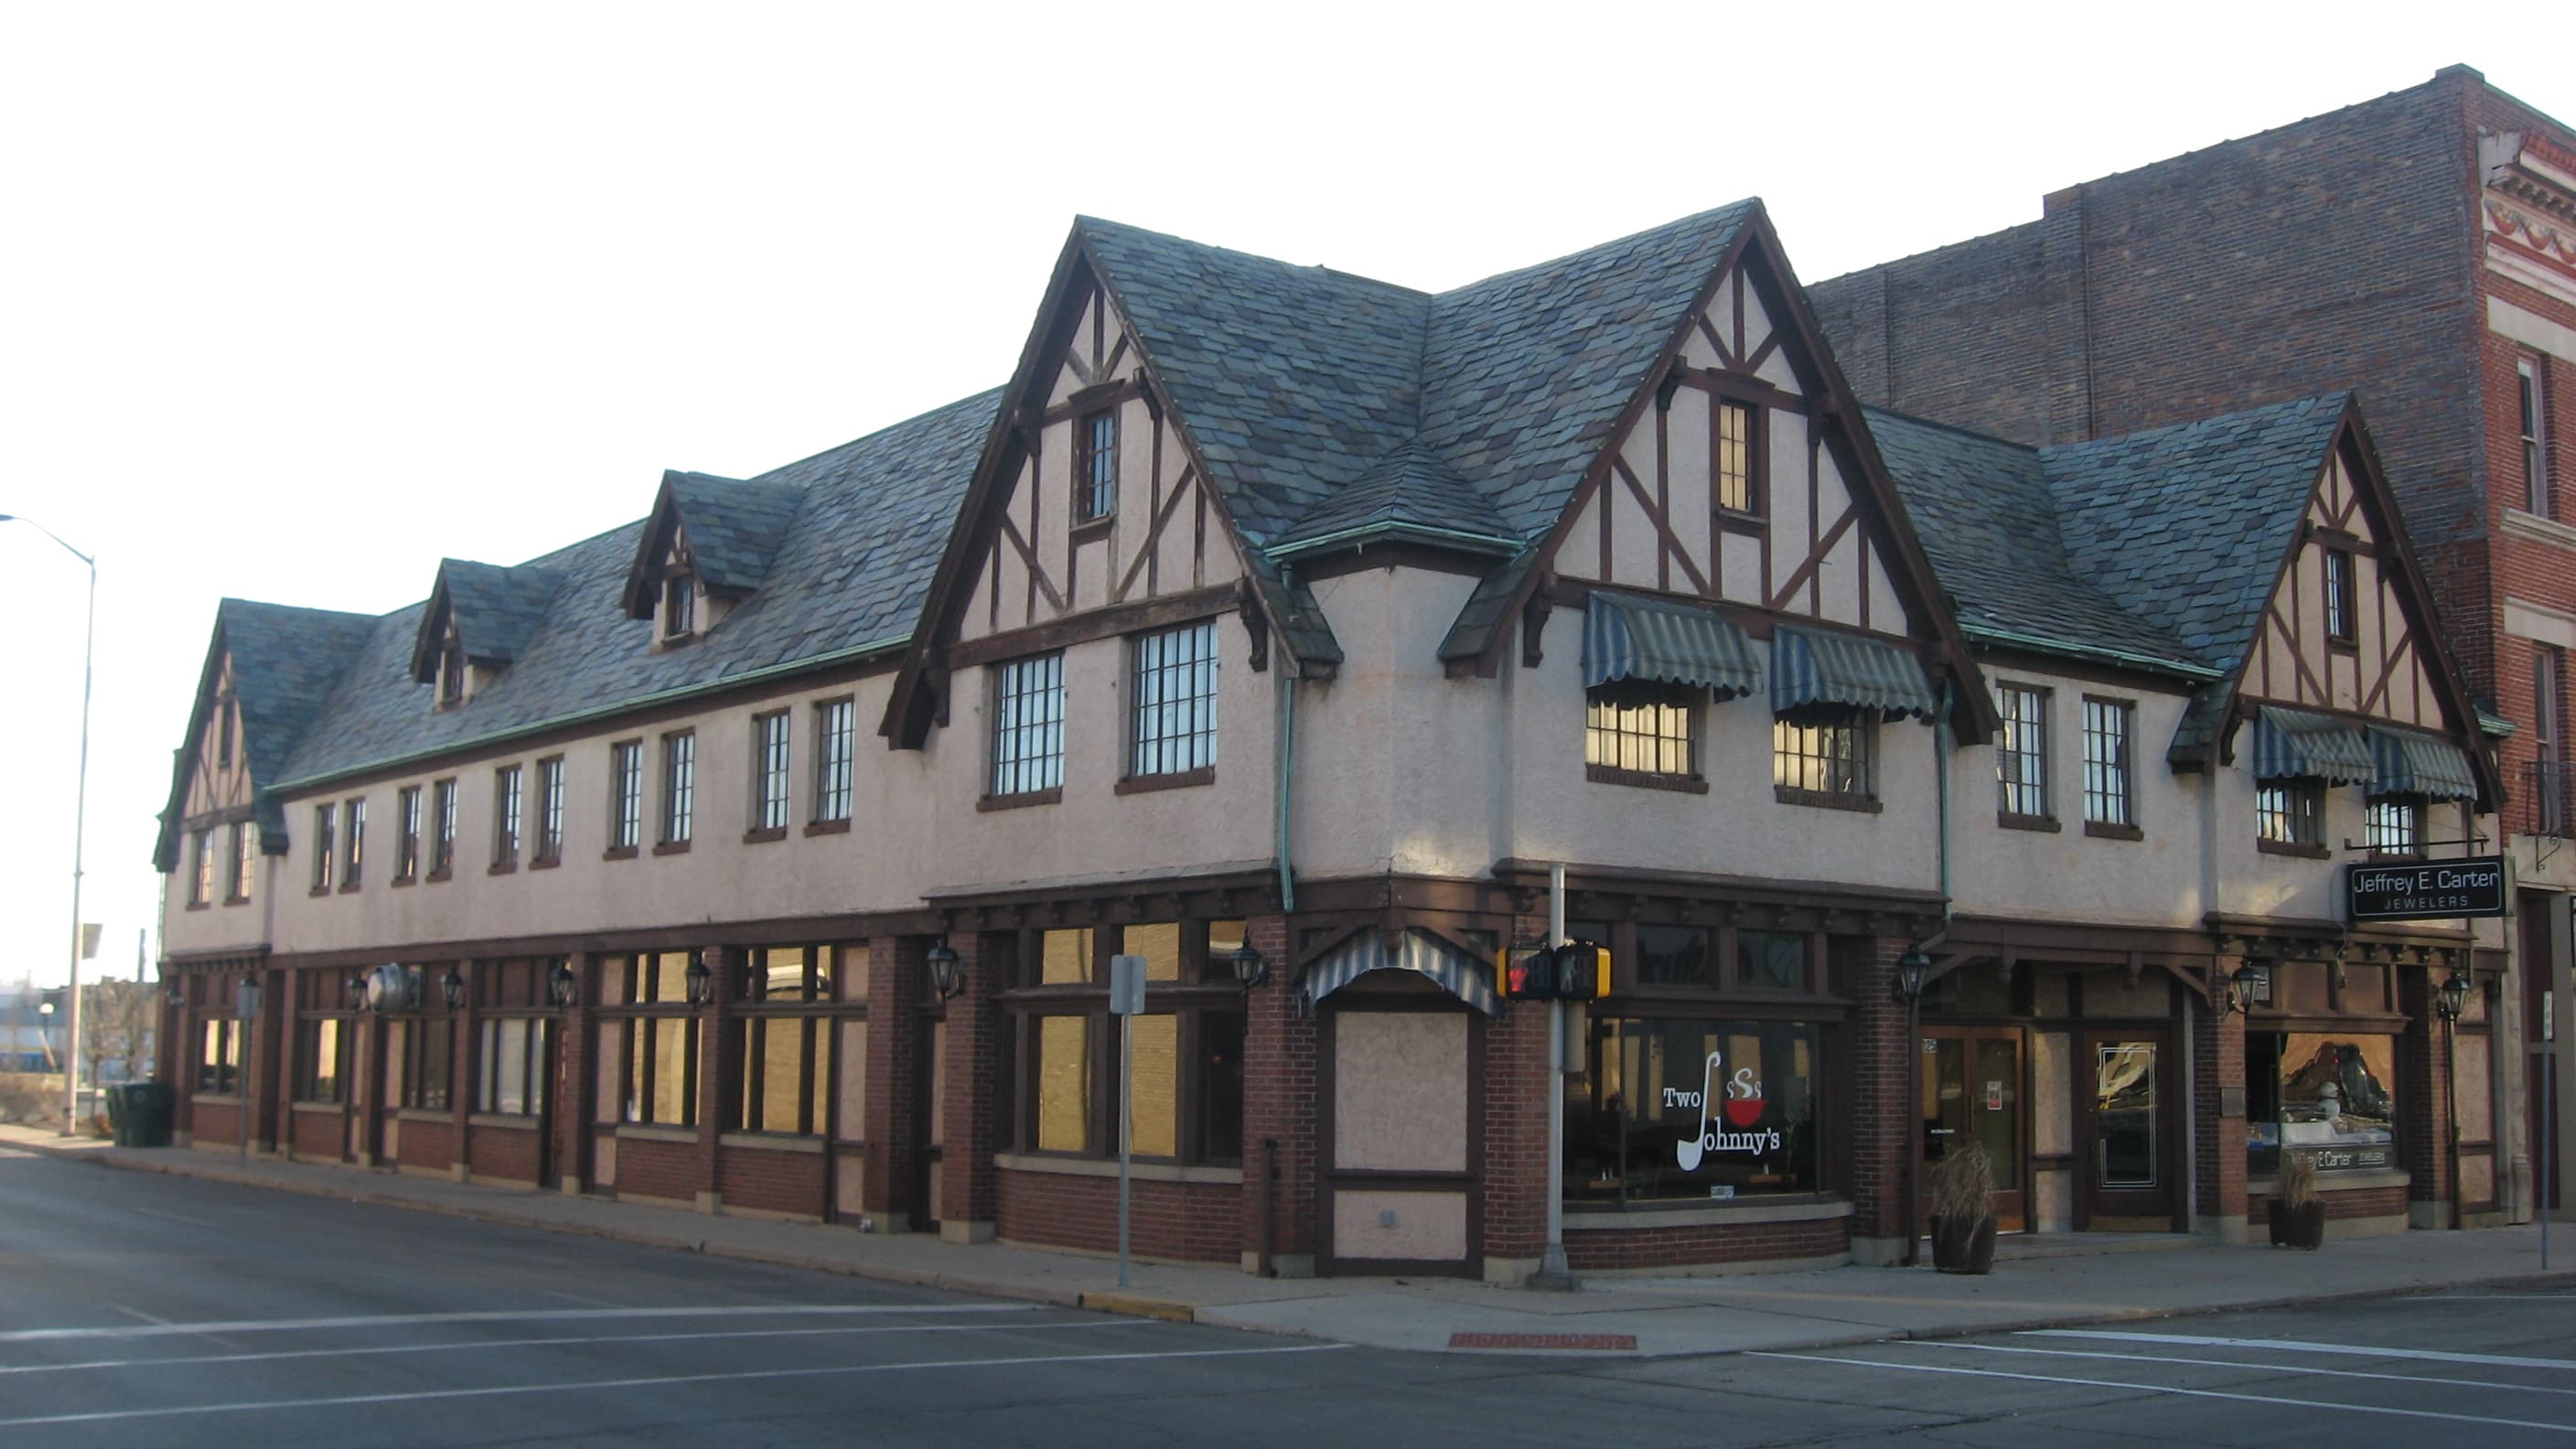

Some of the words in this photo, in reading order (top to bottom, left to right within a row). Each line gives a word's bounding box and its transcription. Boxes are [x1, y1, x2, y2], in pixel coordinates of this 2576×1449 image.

[2355, 873, 2413, 896] Jeffrey
[2418, 871, 2433, 890] E.
[2438, 870, 2498, 889] Carter
[2385, 896, 2469, 909] JEWELERS
[1663, 1087, 1701, 1108] Two
